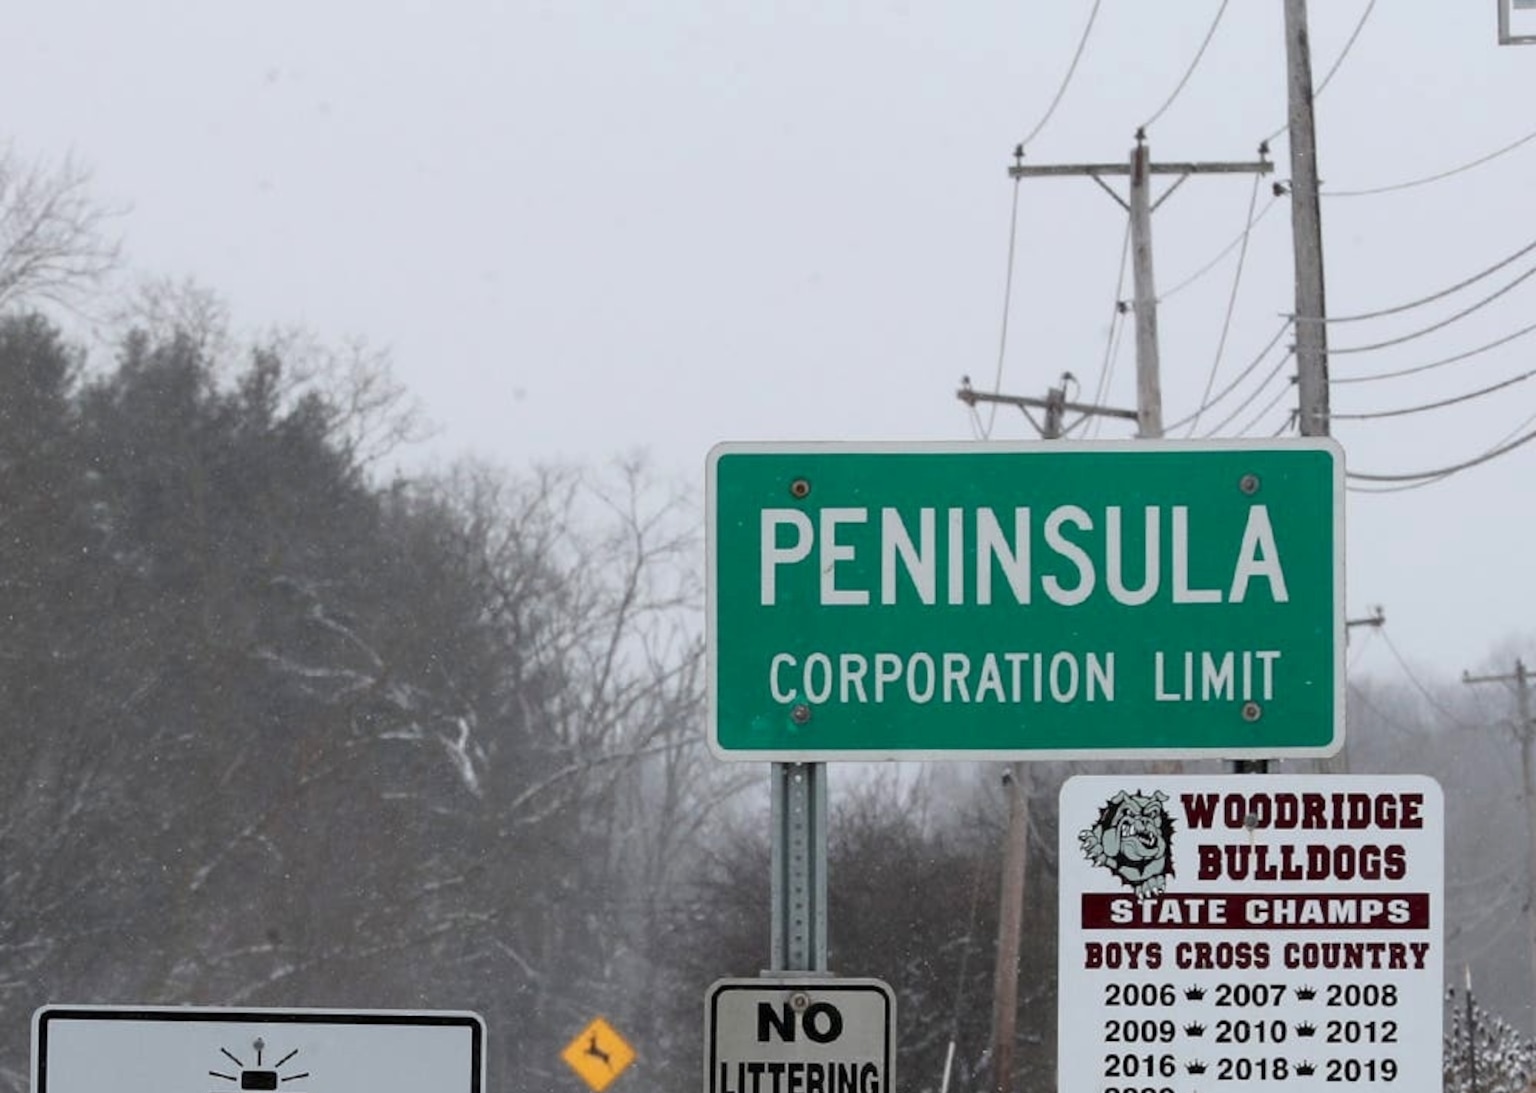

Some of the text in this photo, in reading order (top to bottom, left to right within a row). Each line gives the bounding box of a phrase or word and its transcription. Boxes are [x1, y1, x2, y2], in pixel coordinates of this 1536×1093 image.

[761, 505, 1289, 606] PENINSULA
[770, 651, 1281, 704] CORPORATION LIMIT
[1181, 793, 1424, 829] WOODRIDGE
[1198, 845, 1406, 880] BULLDOGS
[1111, 898, 1410, 924] STATE CHAMPS
[1085, 942, 1430, 970] BOYS CROSS COUNTRY
[1104, 984, 1398, 1007] 2006 2007 2008
[758, 1002, 843, 1043] NO
[1104, 1021, 1397, 1043] 2009 2010 2012
[1104, 1055, 1398, 1082] 2016 2018 2019
